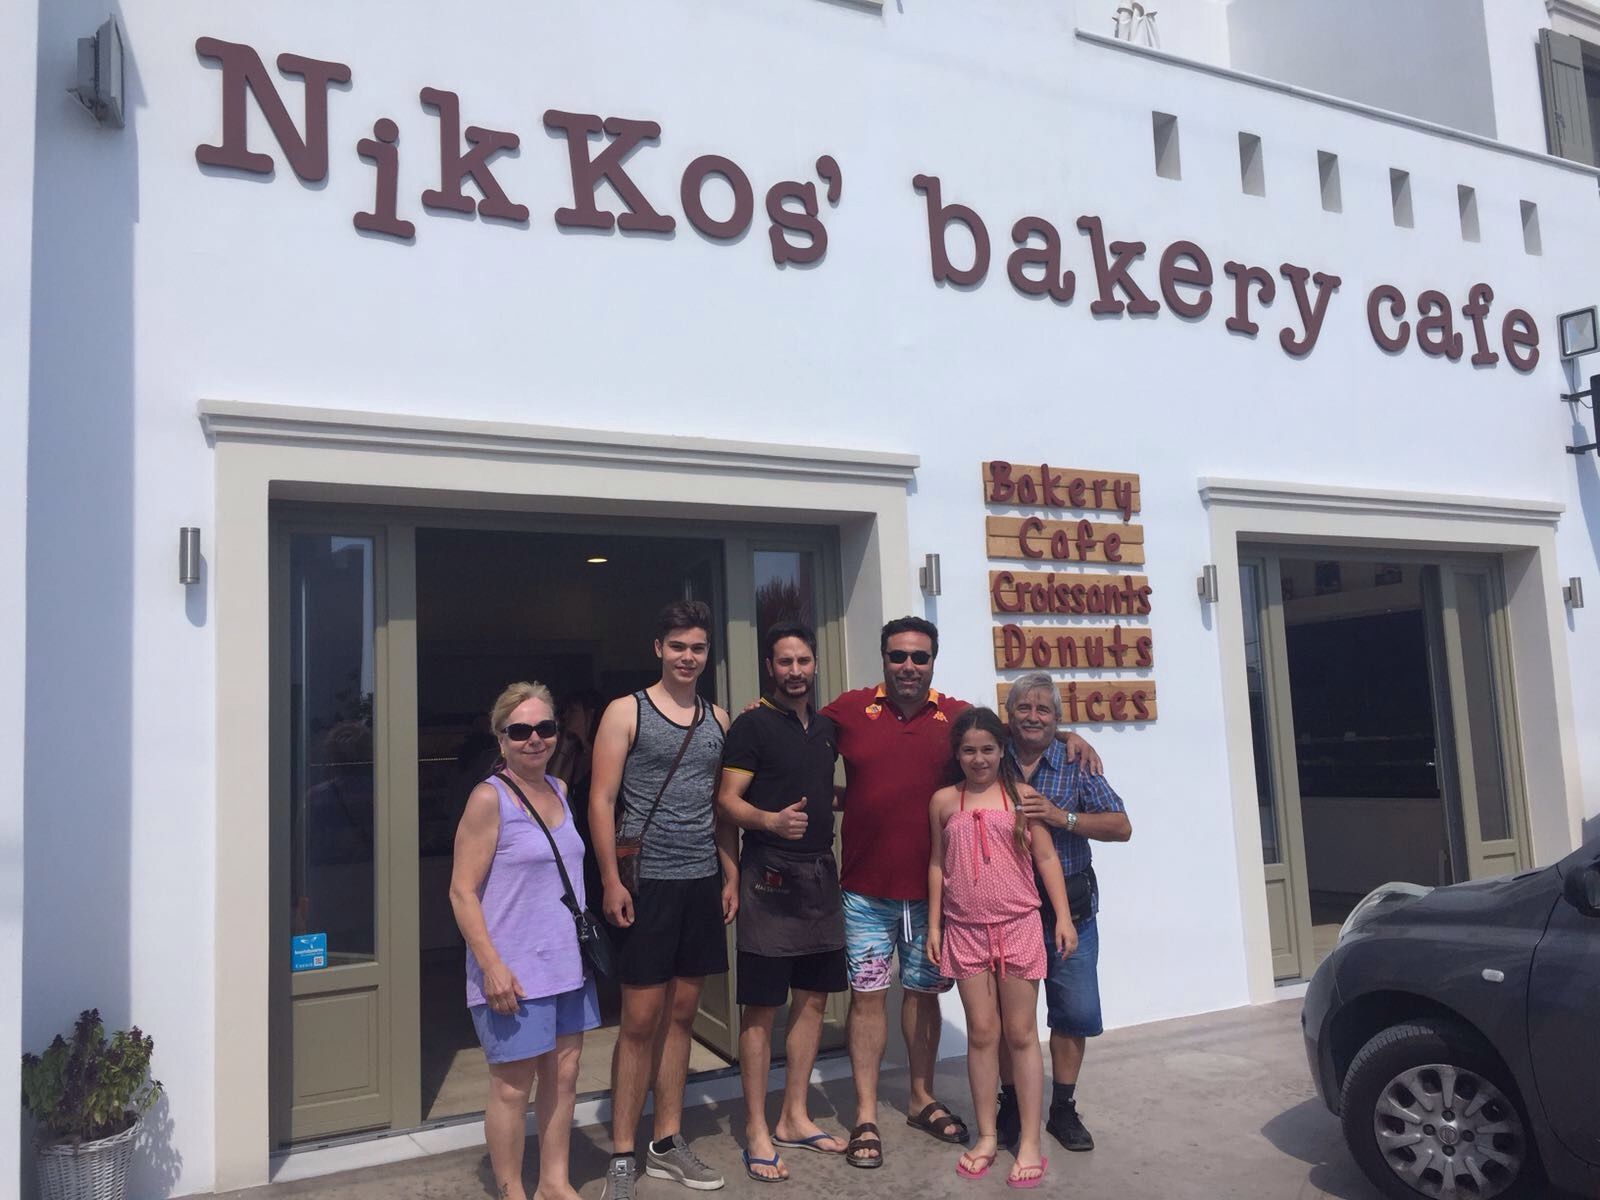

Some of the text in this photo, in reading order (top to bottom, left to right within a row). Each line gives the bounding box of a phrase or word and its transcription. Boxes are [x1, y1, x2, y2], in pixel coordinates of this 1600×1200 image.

[912, 173, 1342, 357] bakery
[1366, 283, 1540, 371] cafe
[989, 460, 1133, 522] Bakery
[1018, 516, 1123, 563] Cafe
[993, 570, 1153, 615] Croissants
[1002, 623, 1153, 669] Donuts
[1067, 681, 1149, 722] ices
